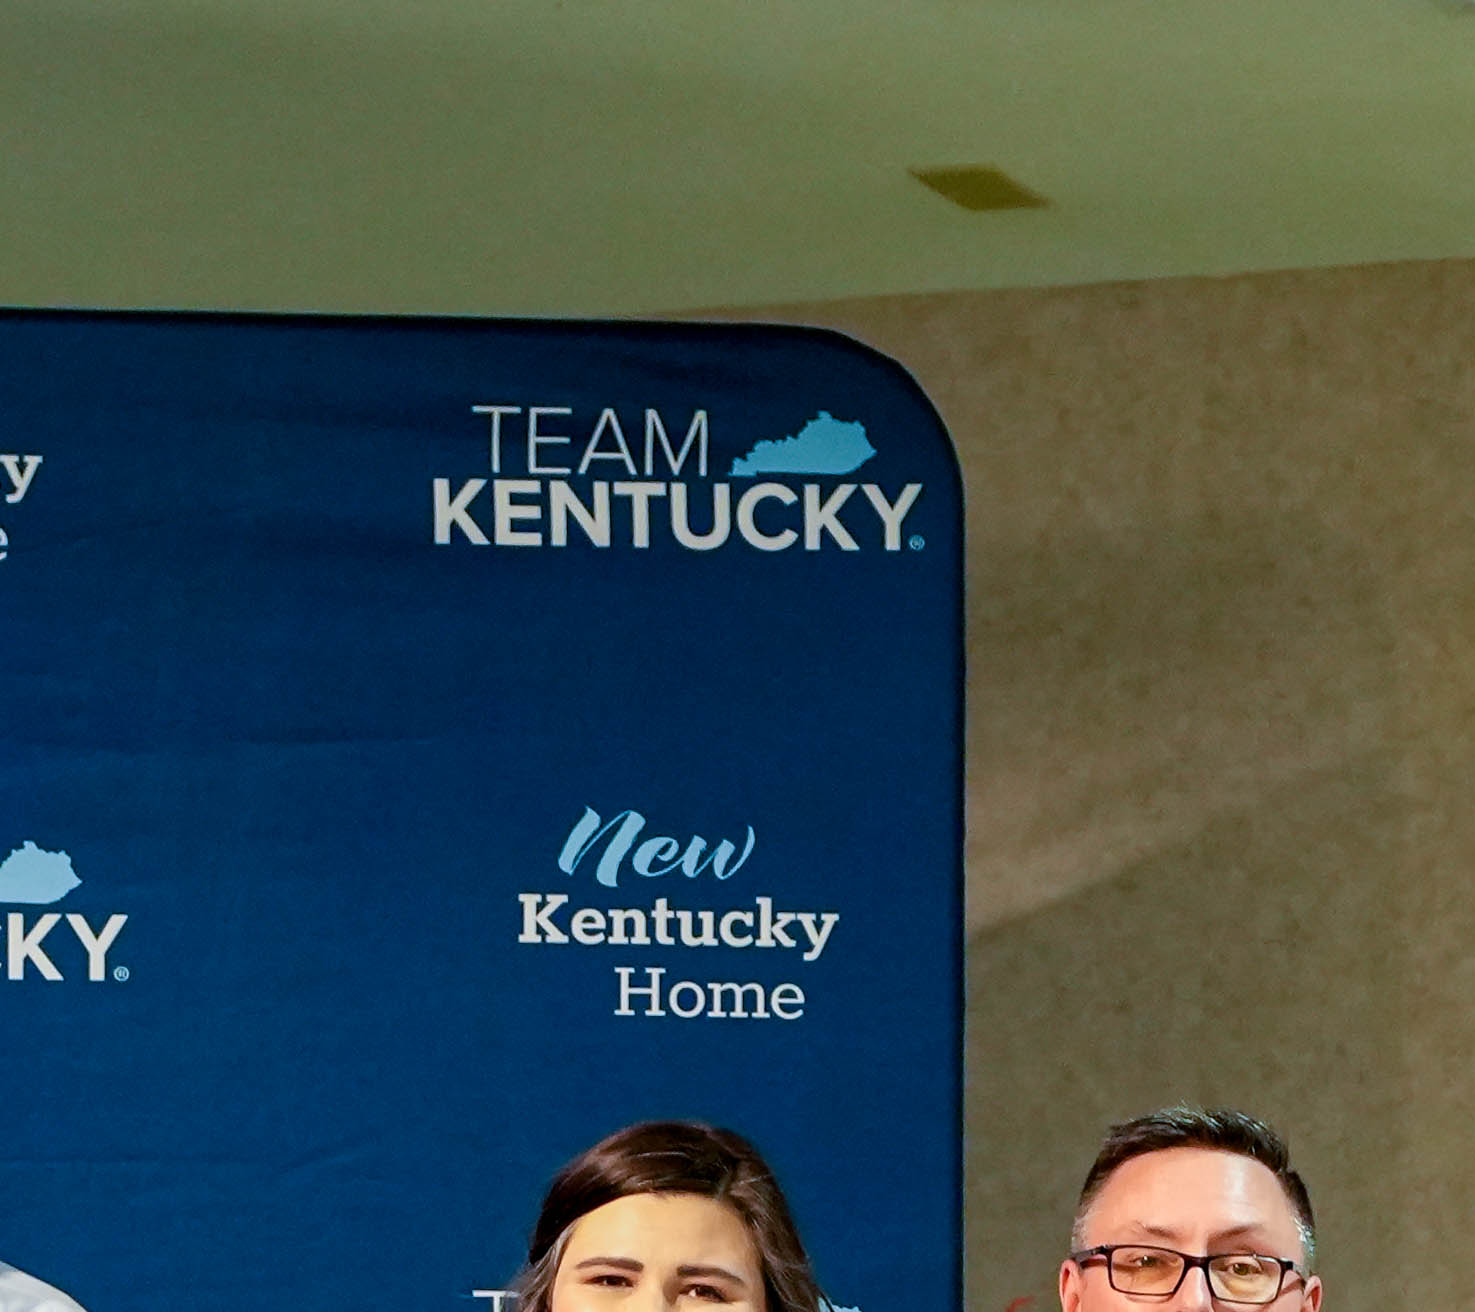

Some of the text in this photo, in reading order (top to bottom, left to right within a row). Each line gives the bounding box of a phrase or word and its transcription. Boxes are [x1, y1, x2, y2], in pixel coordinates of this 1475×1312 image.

[472, 405, 707, 476] TEAM
[433, 478, 922, 551] KENTUCKY
[558, 805, 755, 887] New
[518, 893, 840, 962] Kentucky
[614, 967, 805, 1020] Home
